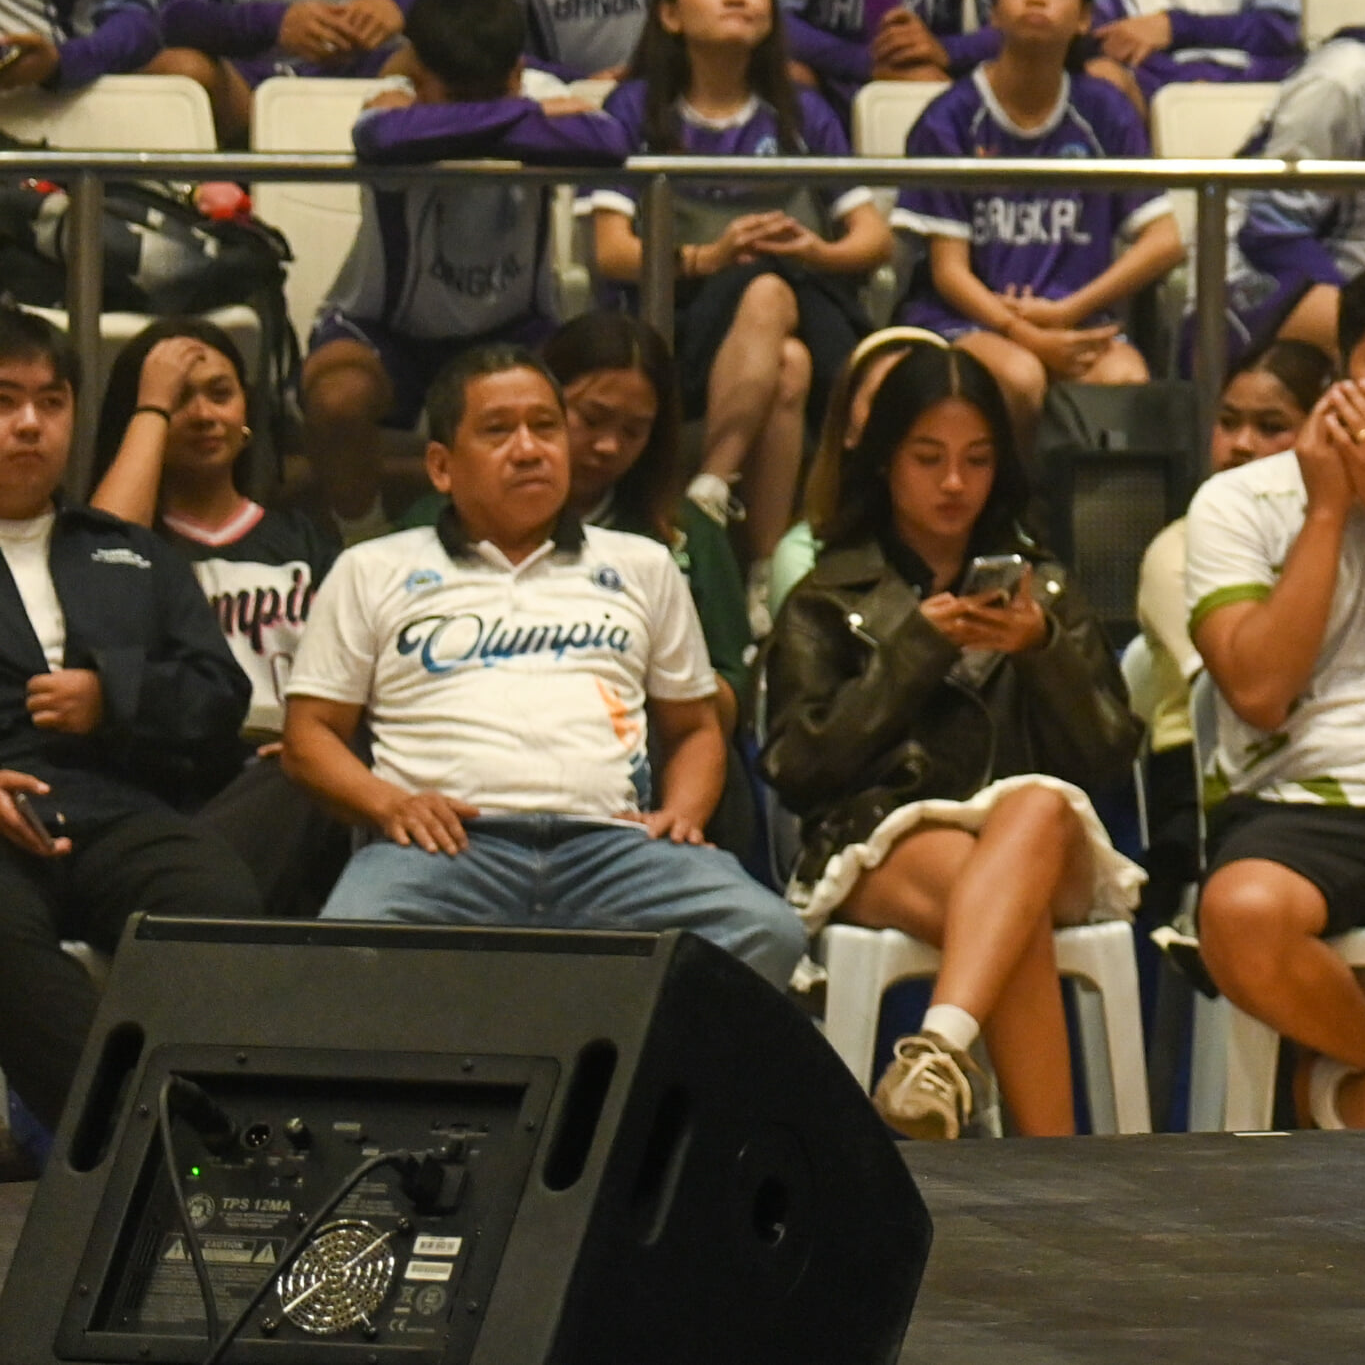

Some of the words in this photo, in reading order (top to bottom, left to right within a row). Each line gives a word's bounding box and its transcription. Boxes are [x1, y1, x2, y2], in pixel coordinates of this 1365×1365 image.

[974, 197, 1092, 246] BANGKAL
[397, 612, 631, 673] Olympia
[223, 1197, 249, 1211] TPS
